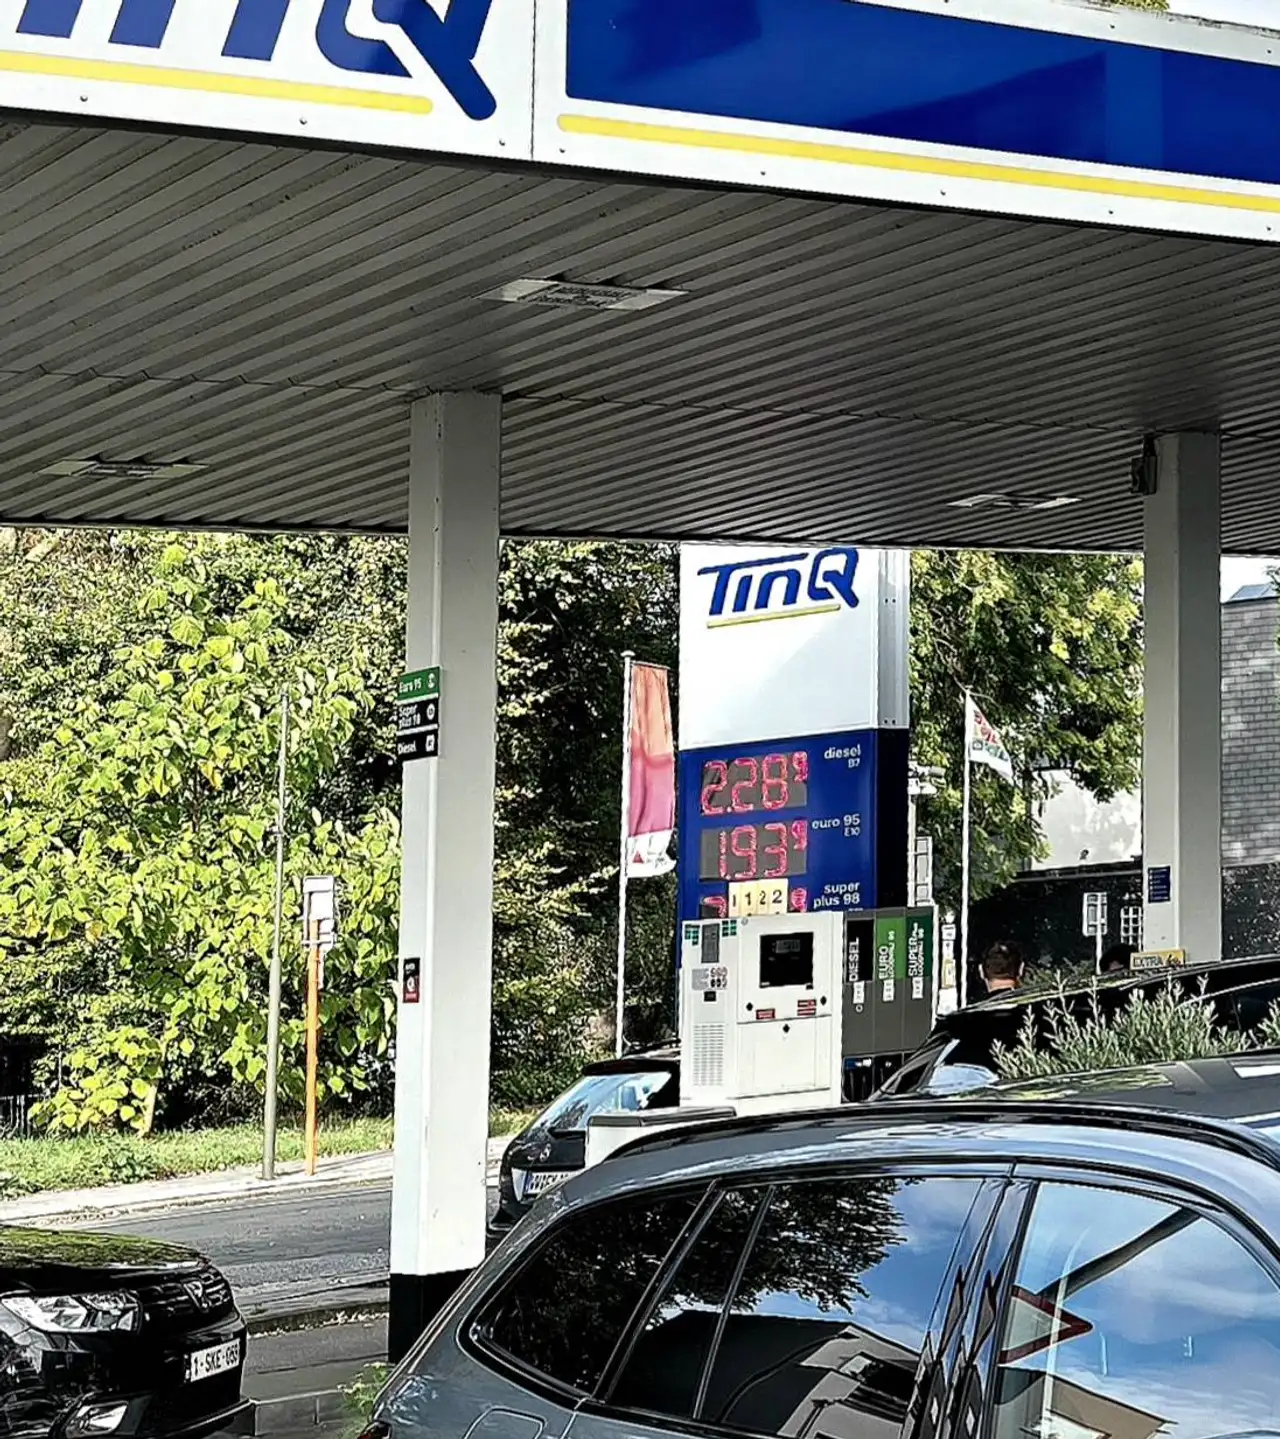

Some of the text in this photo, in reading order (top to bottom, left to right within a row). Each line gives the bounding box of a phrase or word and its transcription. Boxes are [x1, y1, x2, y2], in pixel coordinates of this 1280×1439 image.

[823, 744, 861, 759] diesel
[812, 814, 861, 830] euro 95
[823, 882, 861, 898] super
[813, 896, 840, 909] plus
[843, 892, 861, 905] 98
[849, 937, 859, 981] DIESEL
